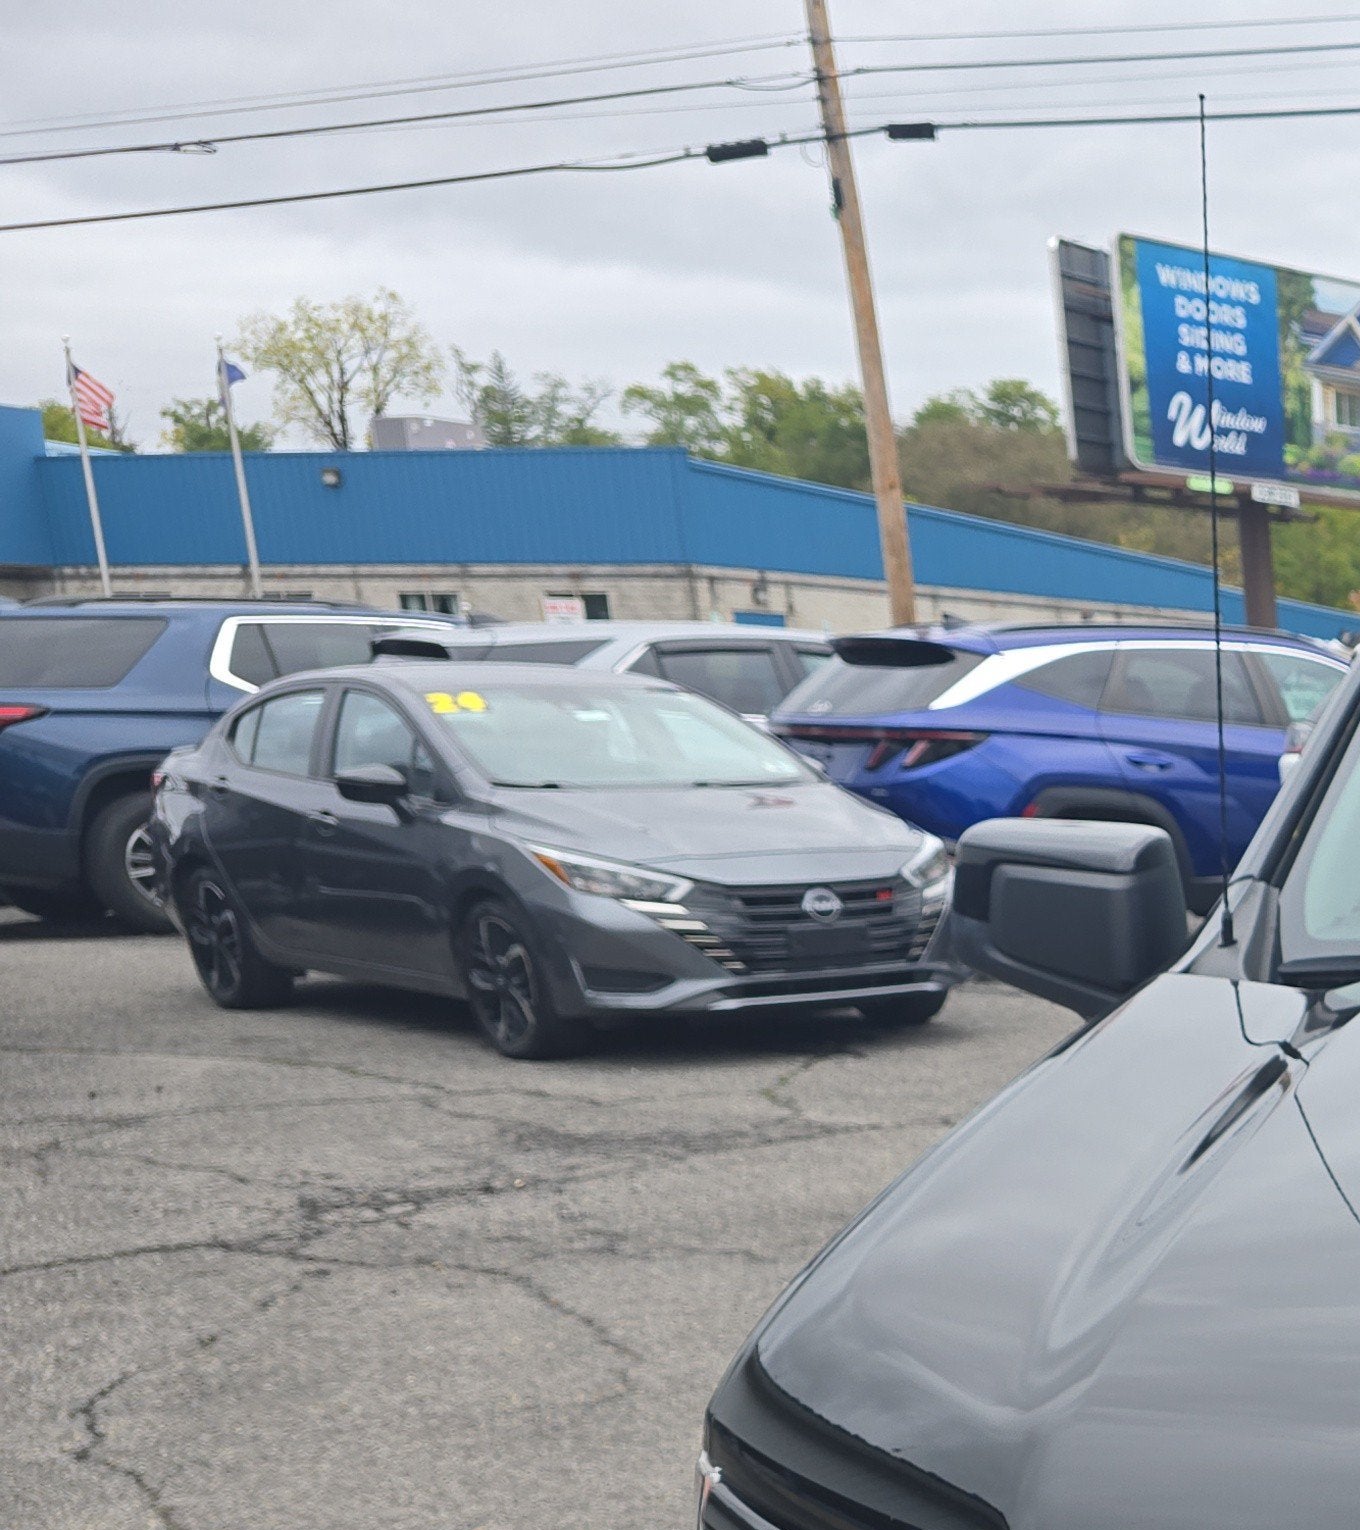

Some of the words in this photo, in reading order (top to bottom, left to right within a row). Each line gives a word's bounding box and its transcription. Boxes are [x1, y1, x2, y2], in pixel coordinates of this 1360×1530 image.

[1155, 262, 1261, 305] WINDOWS
[1174, 294, 1247, 330] DOORS
[1177, 323, 1247, 357] SIDING
[1176, 350, 1192, 375] &
[1194, 352, 1253, 386] MORE
